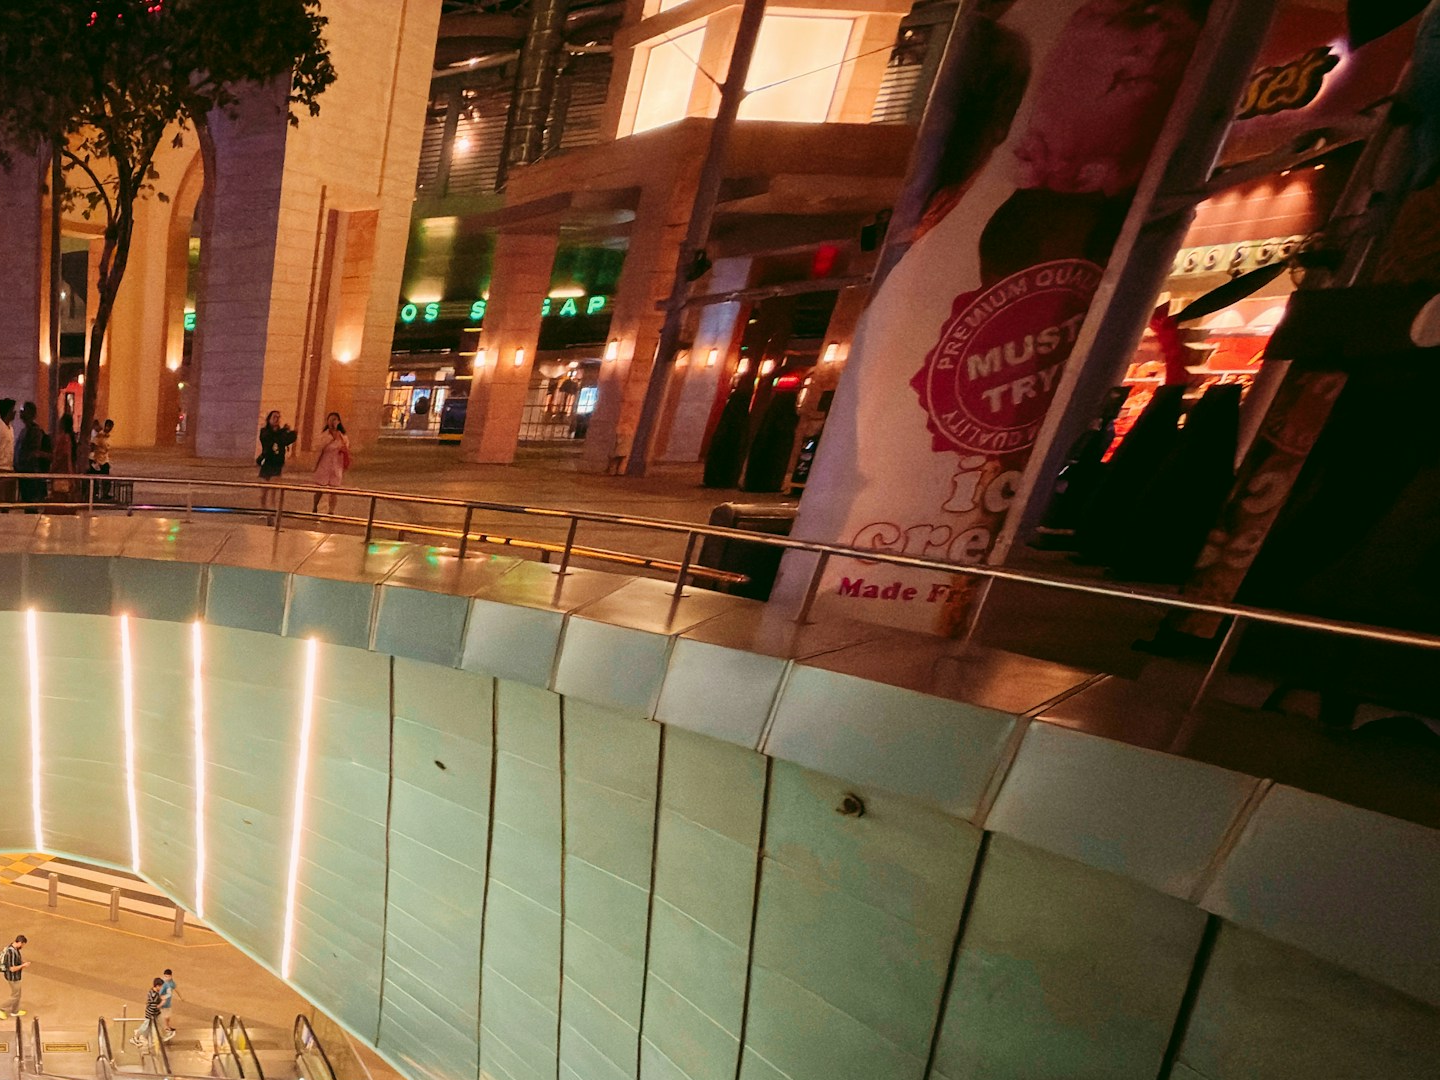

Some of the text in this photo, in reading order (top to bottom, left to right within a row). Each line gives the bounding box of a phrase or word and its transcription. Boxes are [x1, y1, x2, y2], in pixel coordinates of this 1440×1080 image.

[937, 277, 1028, 370] PREMIUM
[967, 312, 1086, 381] MUST
[837, 576, 918, 602] Made
